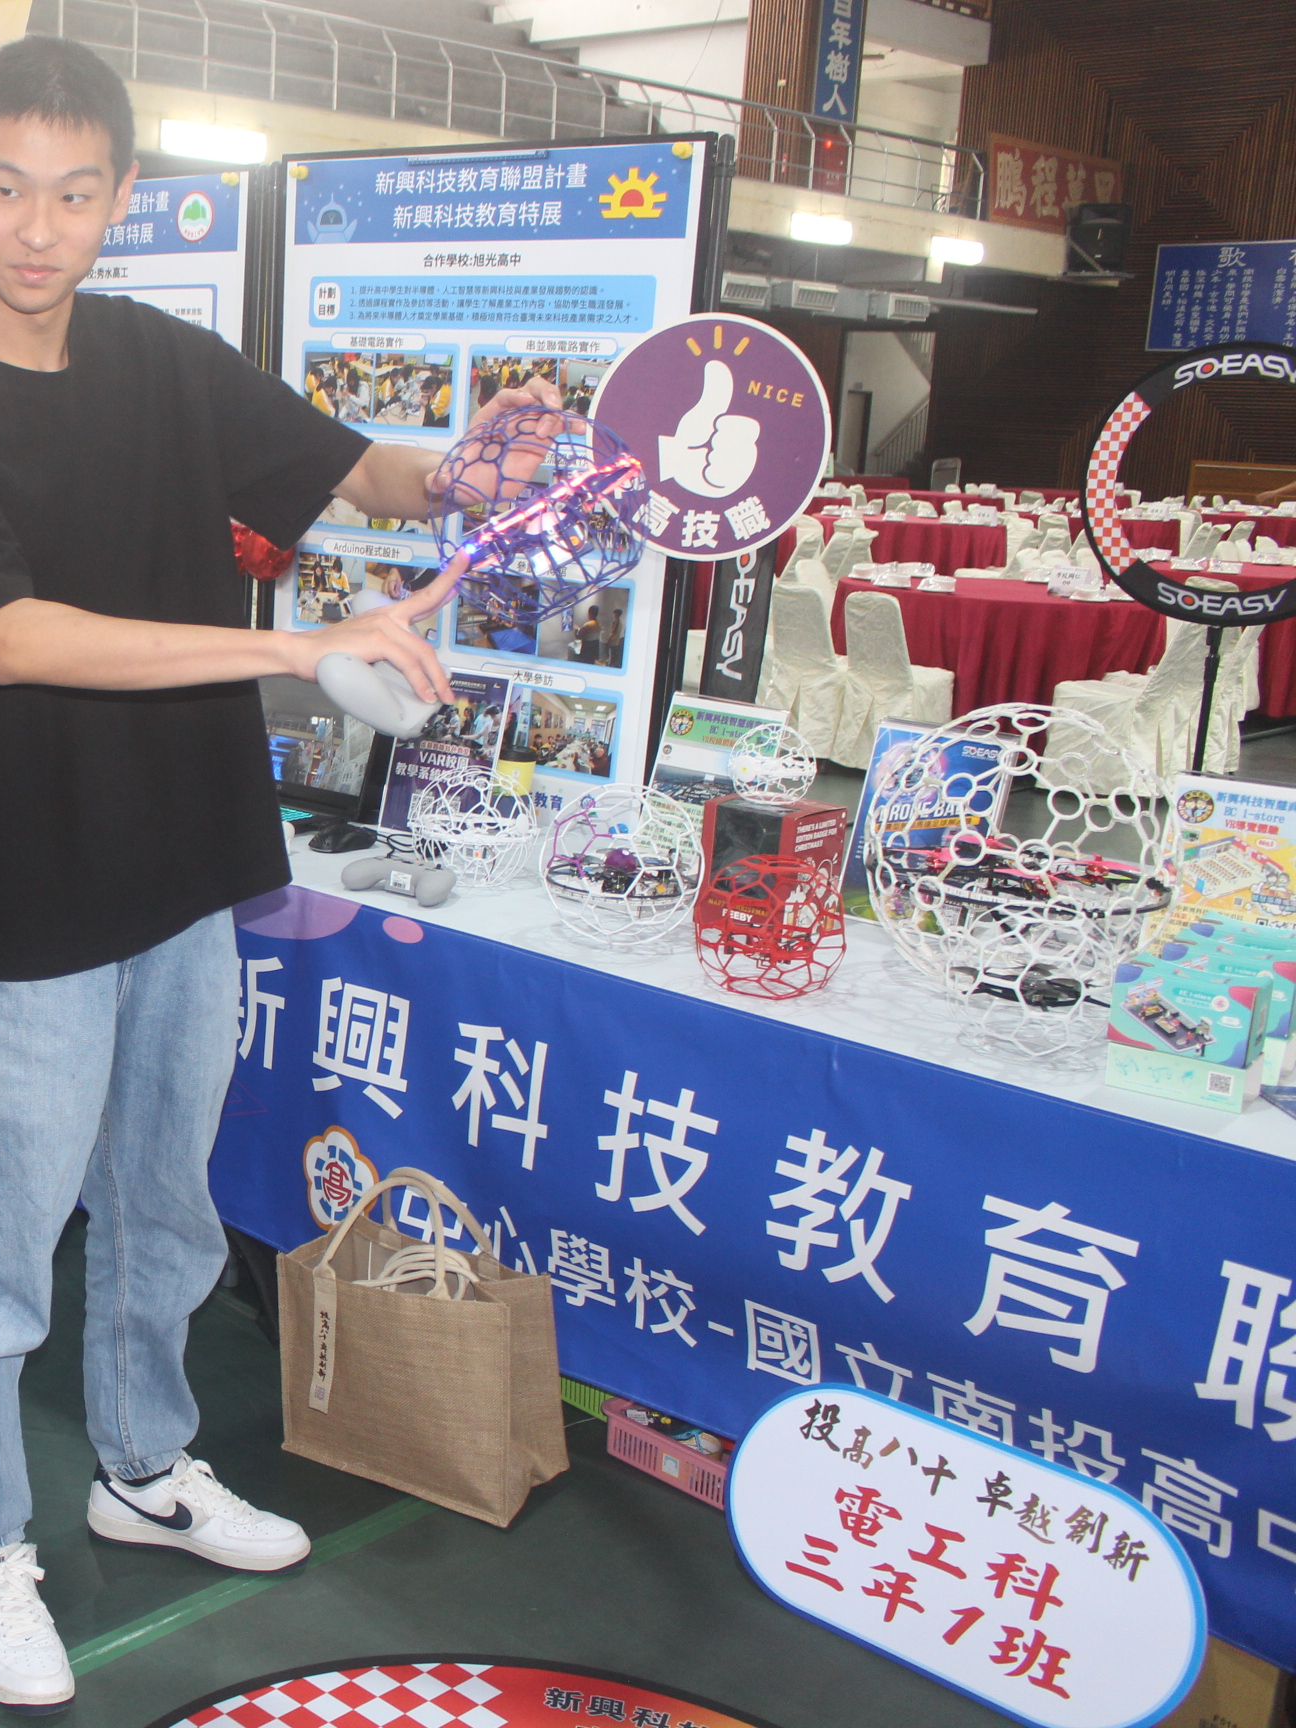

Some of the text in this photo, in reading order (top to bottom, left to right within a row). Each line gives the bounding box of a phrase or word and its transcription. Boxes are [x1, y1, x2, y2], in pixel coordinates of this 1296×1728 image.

[375, 162, 588, 196] 新興科技教育聯盟計畫
[128, 190, 170, 214] 盟計畫
[393, 201, 562, 229] 新興科技教育特展
[423, 252, 521, 268] 合作學校:旭光高中
[1217, 246, 1247, 268] 歌
[318, 286, 336, 299] 計劃
[318, 304, 336, 316] 目標
[350, 335, 404, 348] 基礎電路實作
[525, 339, 601, 354] 串並聯電路實作
[748, 379, 805, 408] NICE
[333, 542, 400, 559] Arduino程式設計
[1157, 581, 1288, 616] SOEASY
[715, 553, 757, 682] OEASY
[514, 670, 554, 687] 大學參訪
[419, 751, 470, 771] VAR校園
[526, 790, 563, 812] 教育
[934, 799, 967, 817] BAL
[828, 828, 837, 836] FOR
[800, 1398, 1150, 1582] 投高八十 卓越創新
[835, 1484, 1065, 1622] 電工科
[784, 1534, 1073, 1700] 三年1班
[544, 1687, 708, 1728] 新興科
